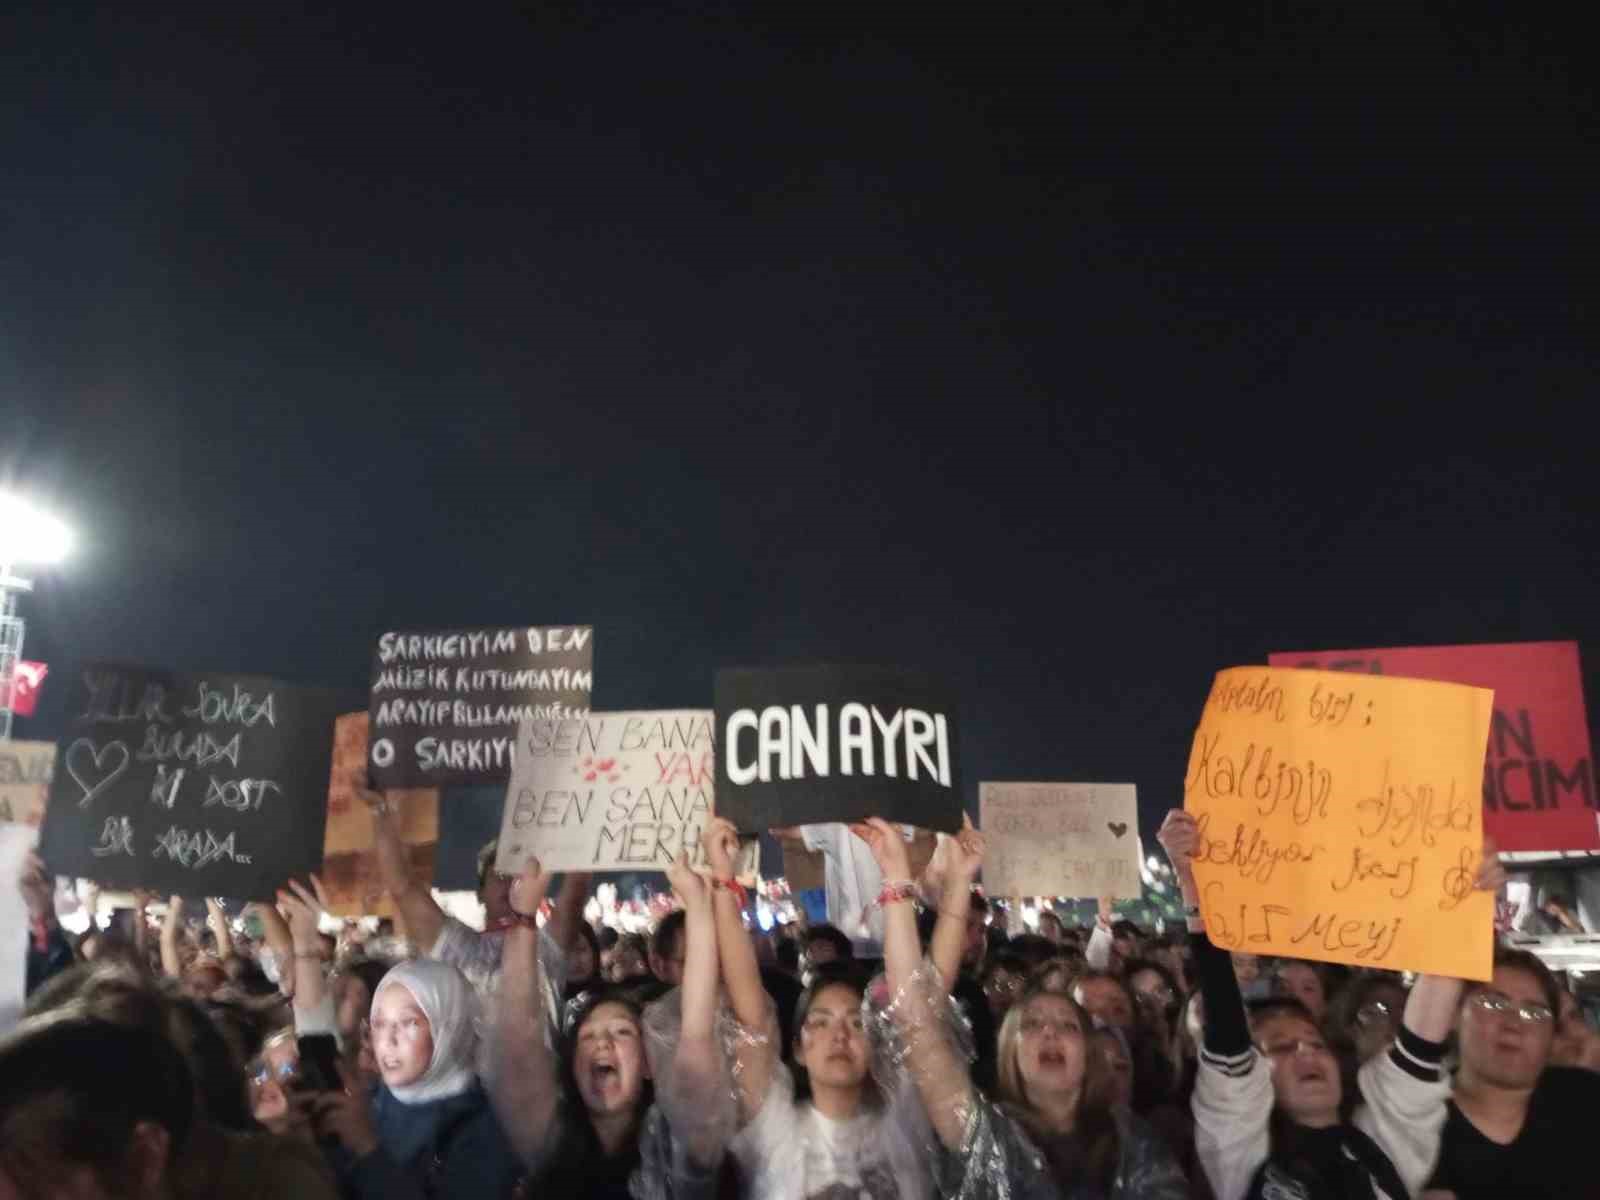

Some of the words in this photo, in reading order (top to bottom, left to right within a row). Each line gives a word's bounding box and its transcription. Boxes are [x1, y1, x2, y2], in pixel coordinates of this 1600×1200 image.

[371, 738, 395, 767] O
[528, 718, 604, 756] SEN
[620, 718, 714, 751] BANA
[726, 704, 829, 785] CAN
[840, 702, 952, 788] AYRI
[512, 788, 594, 828] BEN
[606, 786, 709, 823] SANA
